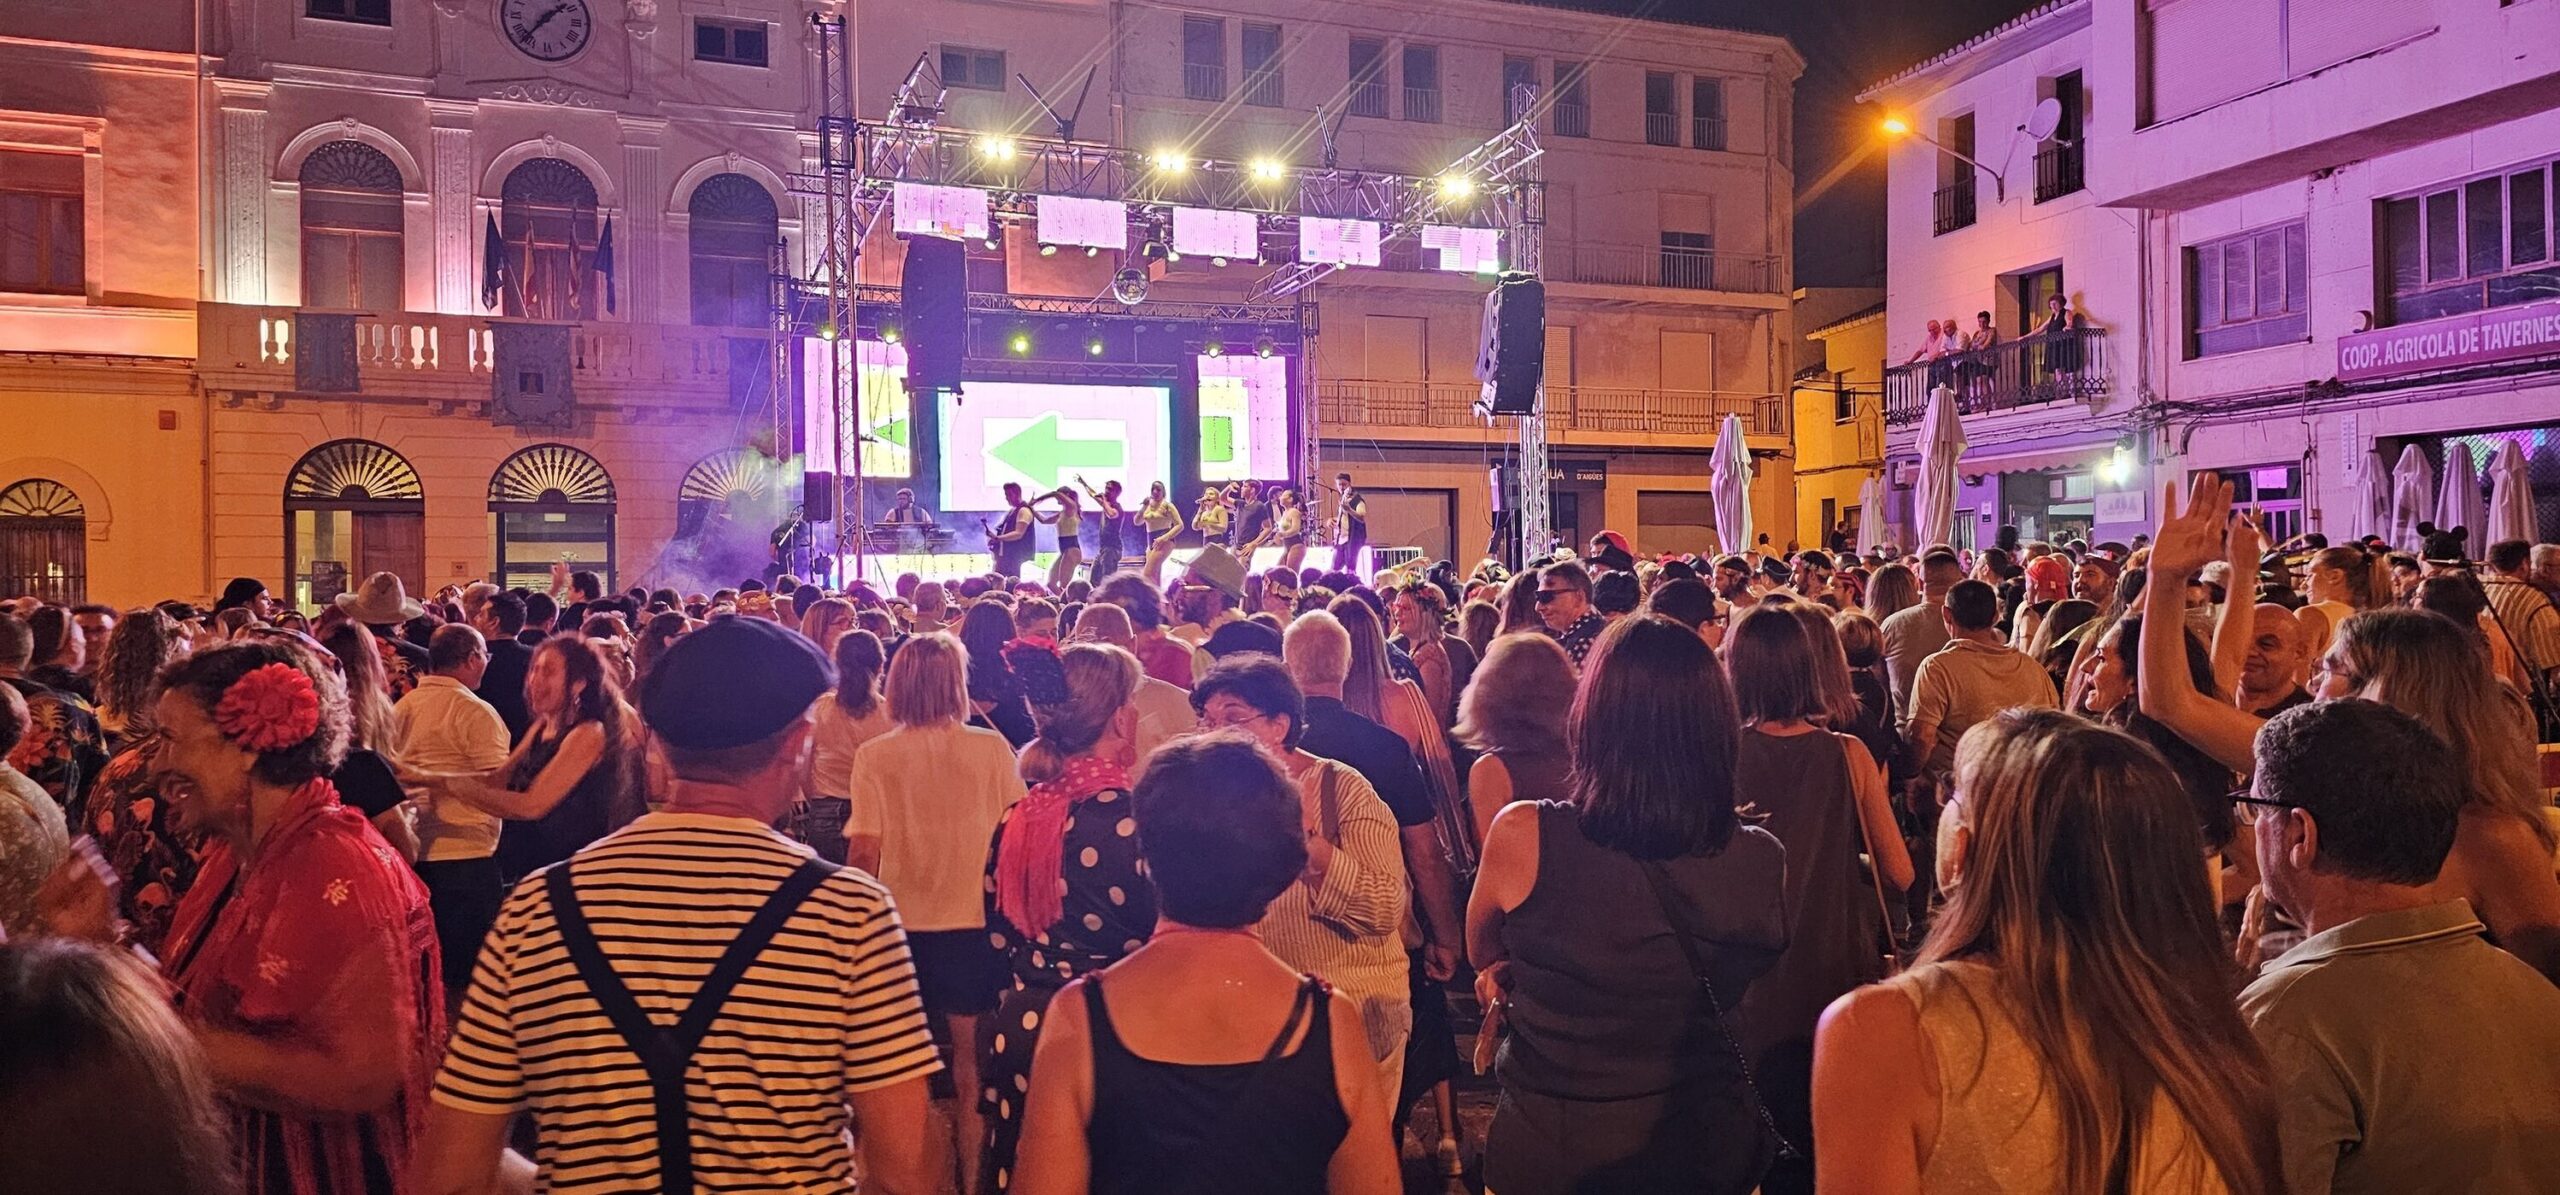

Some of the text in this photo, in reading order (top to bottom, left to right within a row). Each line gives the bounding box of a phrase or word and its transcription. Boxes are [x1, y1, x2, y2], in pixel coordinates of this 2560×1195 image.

[2341, 314, 2560, 371] COOP. AGRICOLA DE TAVERNES
